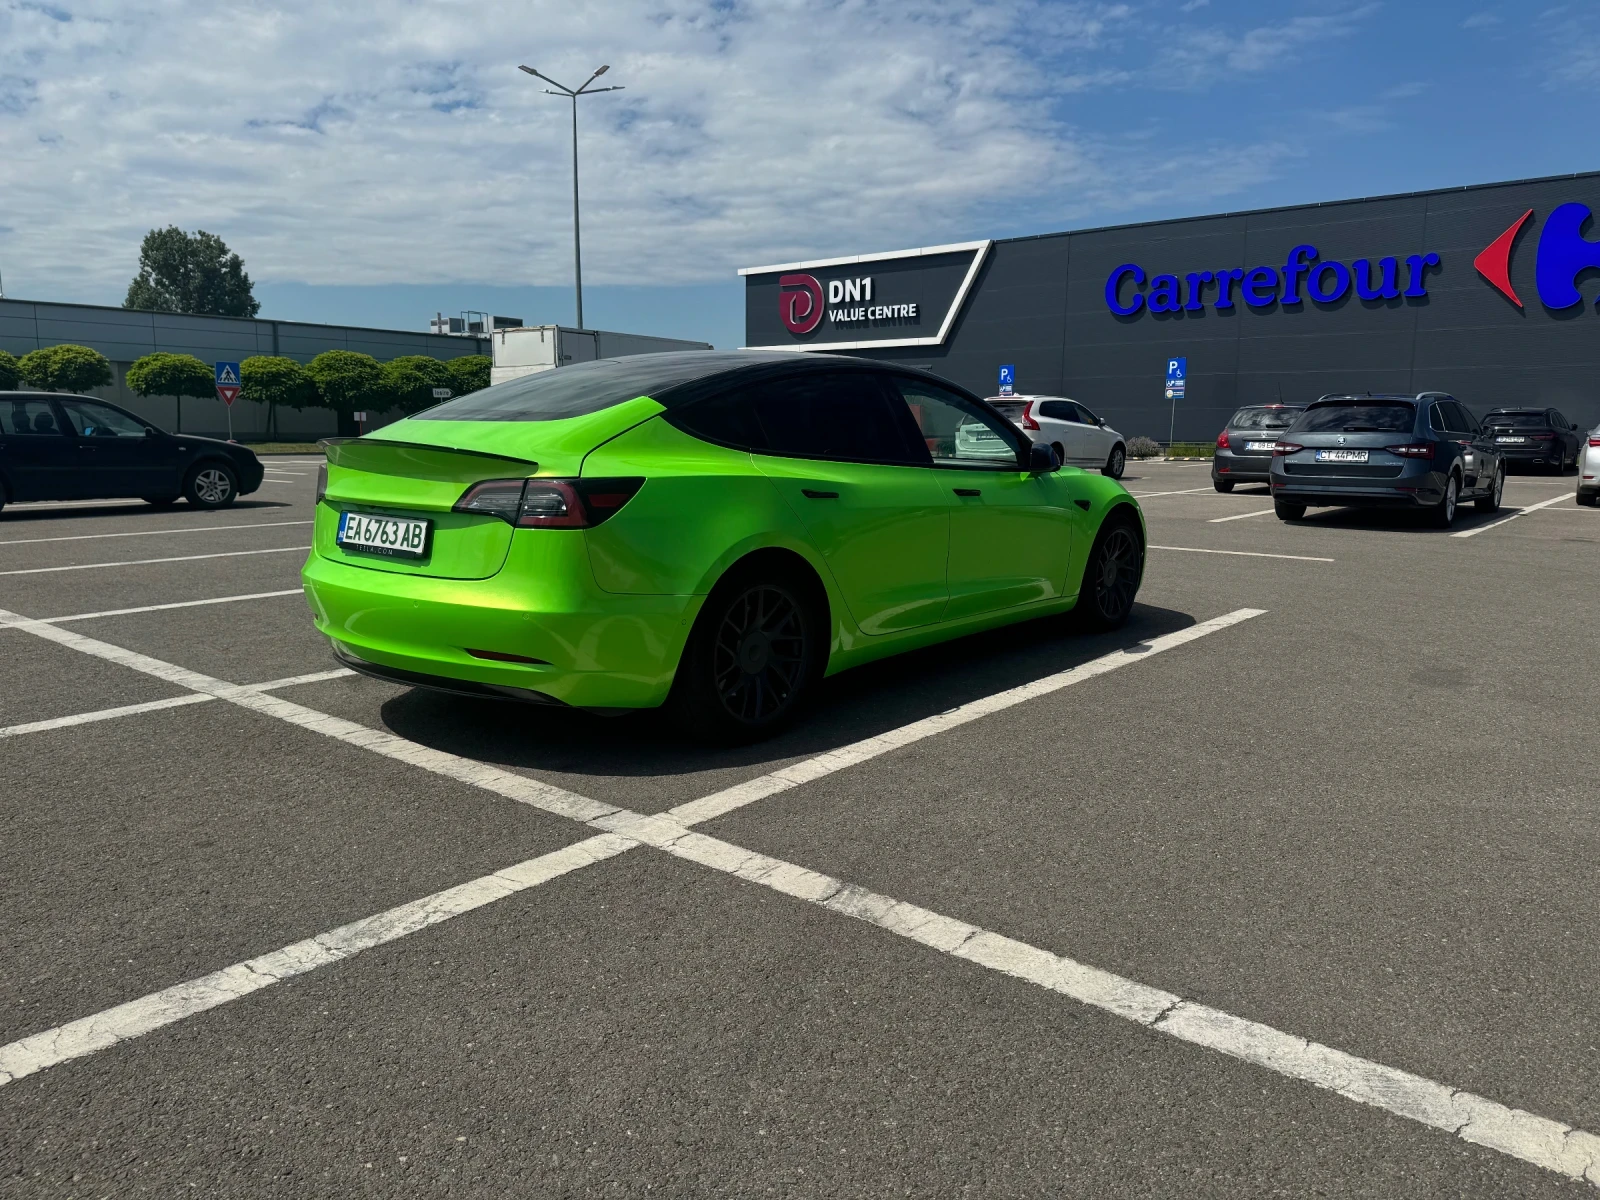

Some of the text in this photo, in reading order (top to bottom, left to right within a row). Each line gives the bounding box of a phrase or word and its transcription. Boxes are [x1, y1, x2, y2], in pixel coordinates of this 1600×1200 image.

[829, 277, 872, 303] DN1
[1105, 245, 1440, 316] Carrefour
[829, 303, 917, 322] VALUE CENTRE
[345, 516, 423, 549] EA 6763 AB
